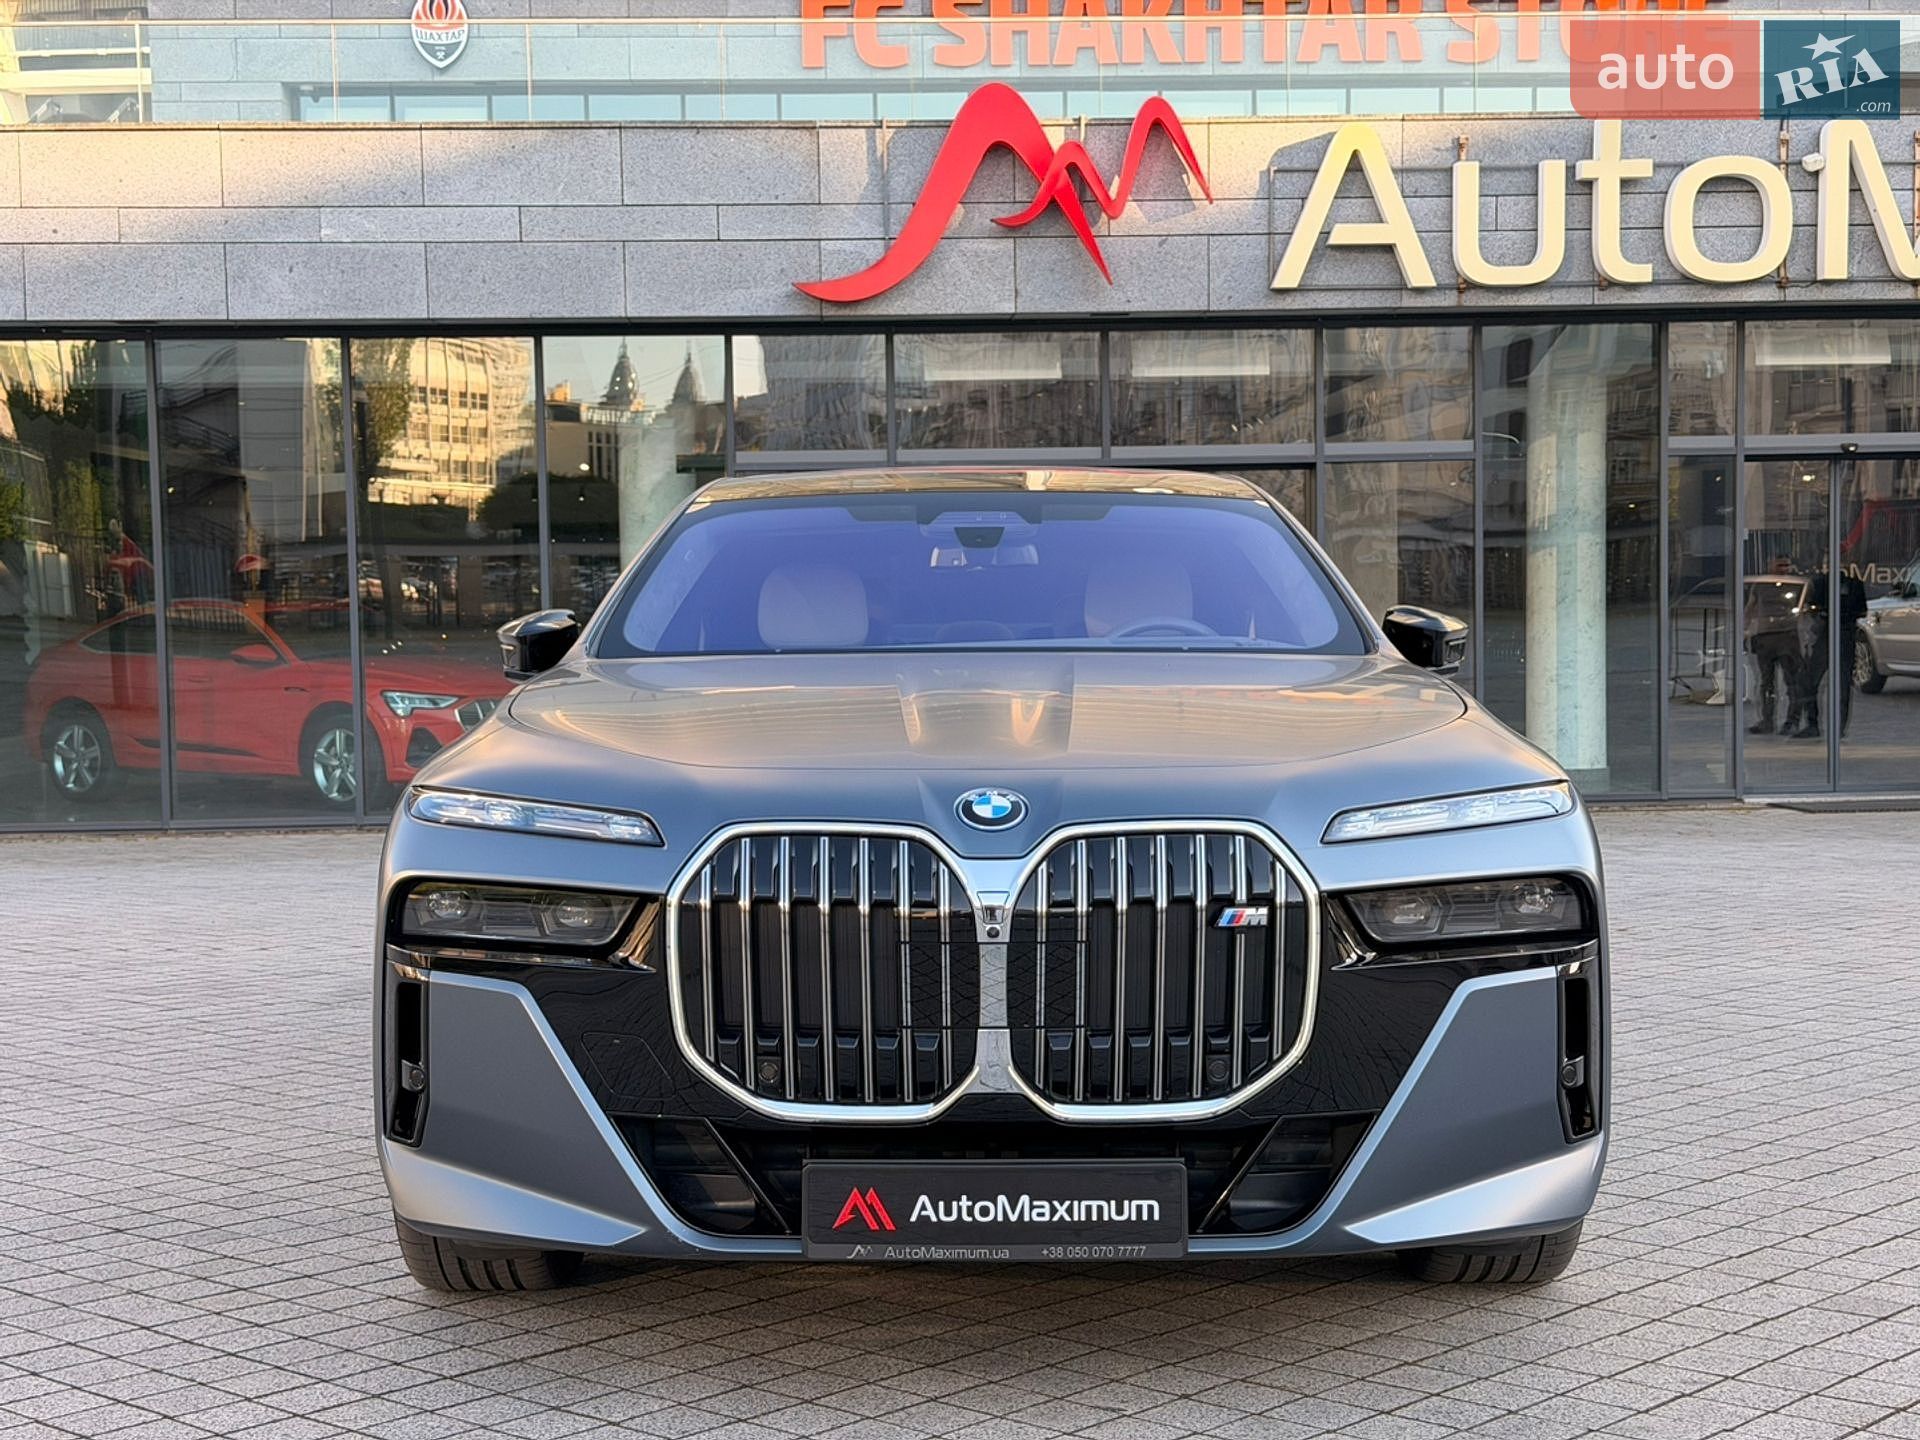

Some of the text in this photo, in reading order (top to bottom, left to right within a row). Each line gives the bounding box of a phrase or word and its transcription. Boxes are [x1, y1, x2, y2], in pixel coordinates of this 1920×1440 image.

[415, 29, 465, 42] ШАХТАР
[801, 0, 909, 68] FC
[932, 0, 1424, 67] SHAKHTAR
[909, 1194, 1160, 1223] AutoMaximum
[884, 1246, 1147, 1259] AutoMaximum.ua +38 050 070 7777
